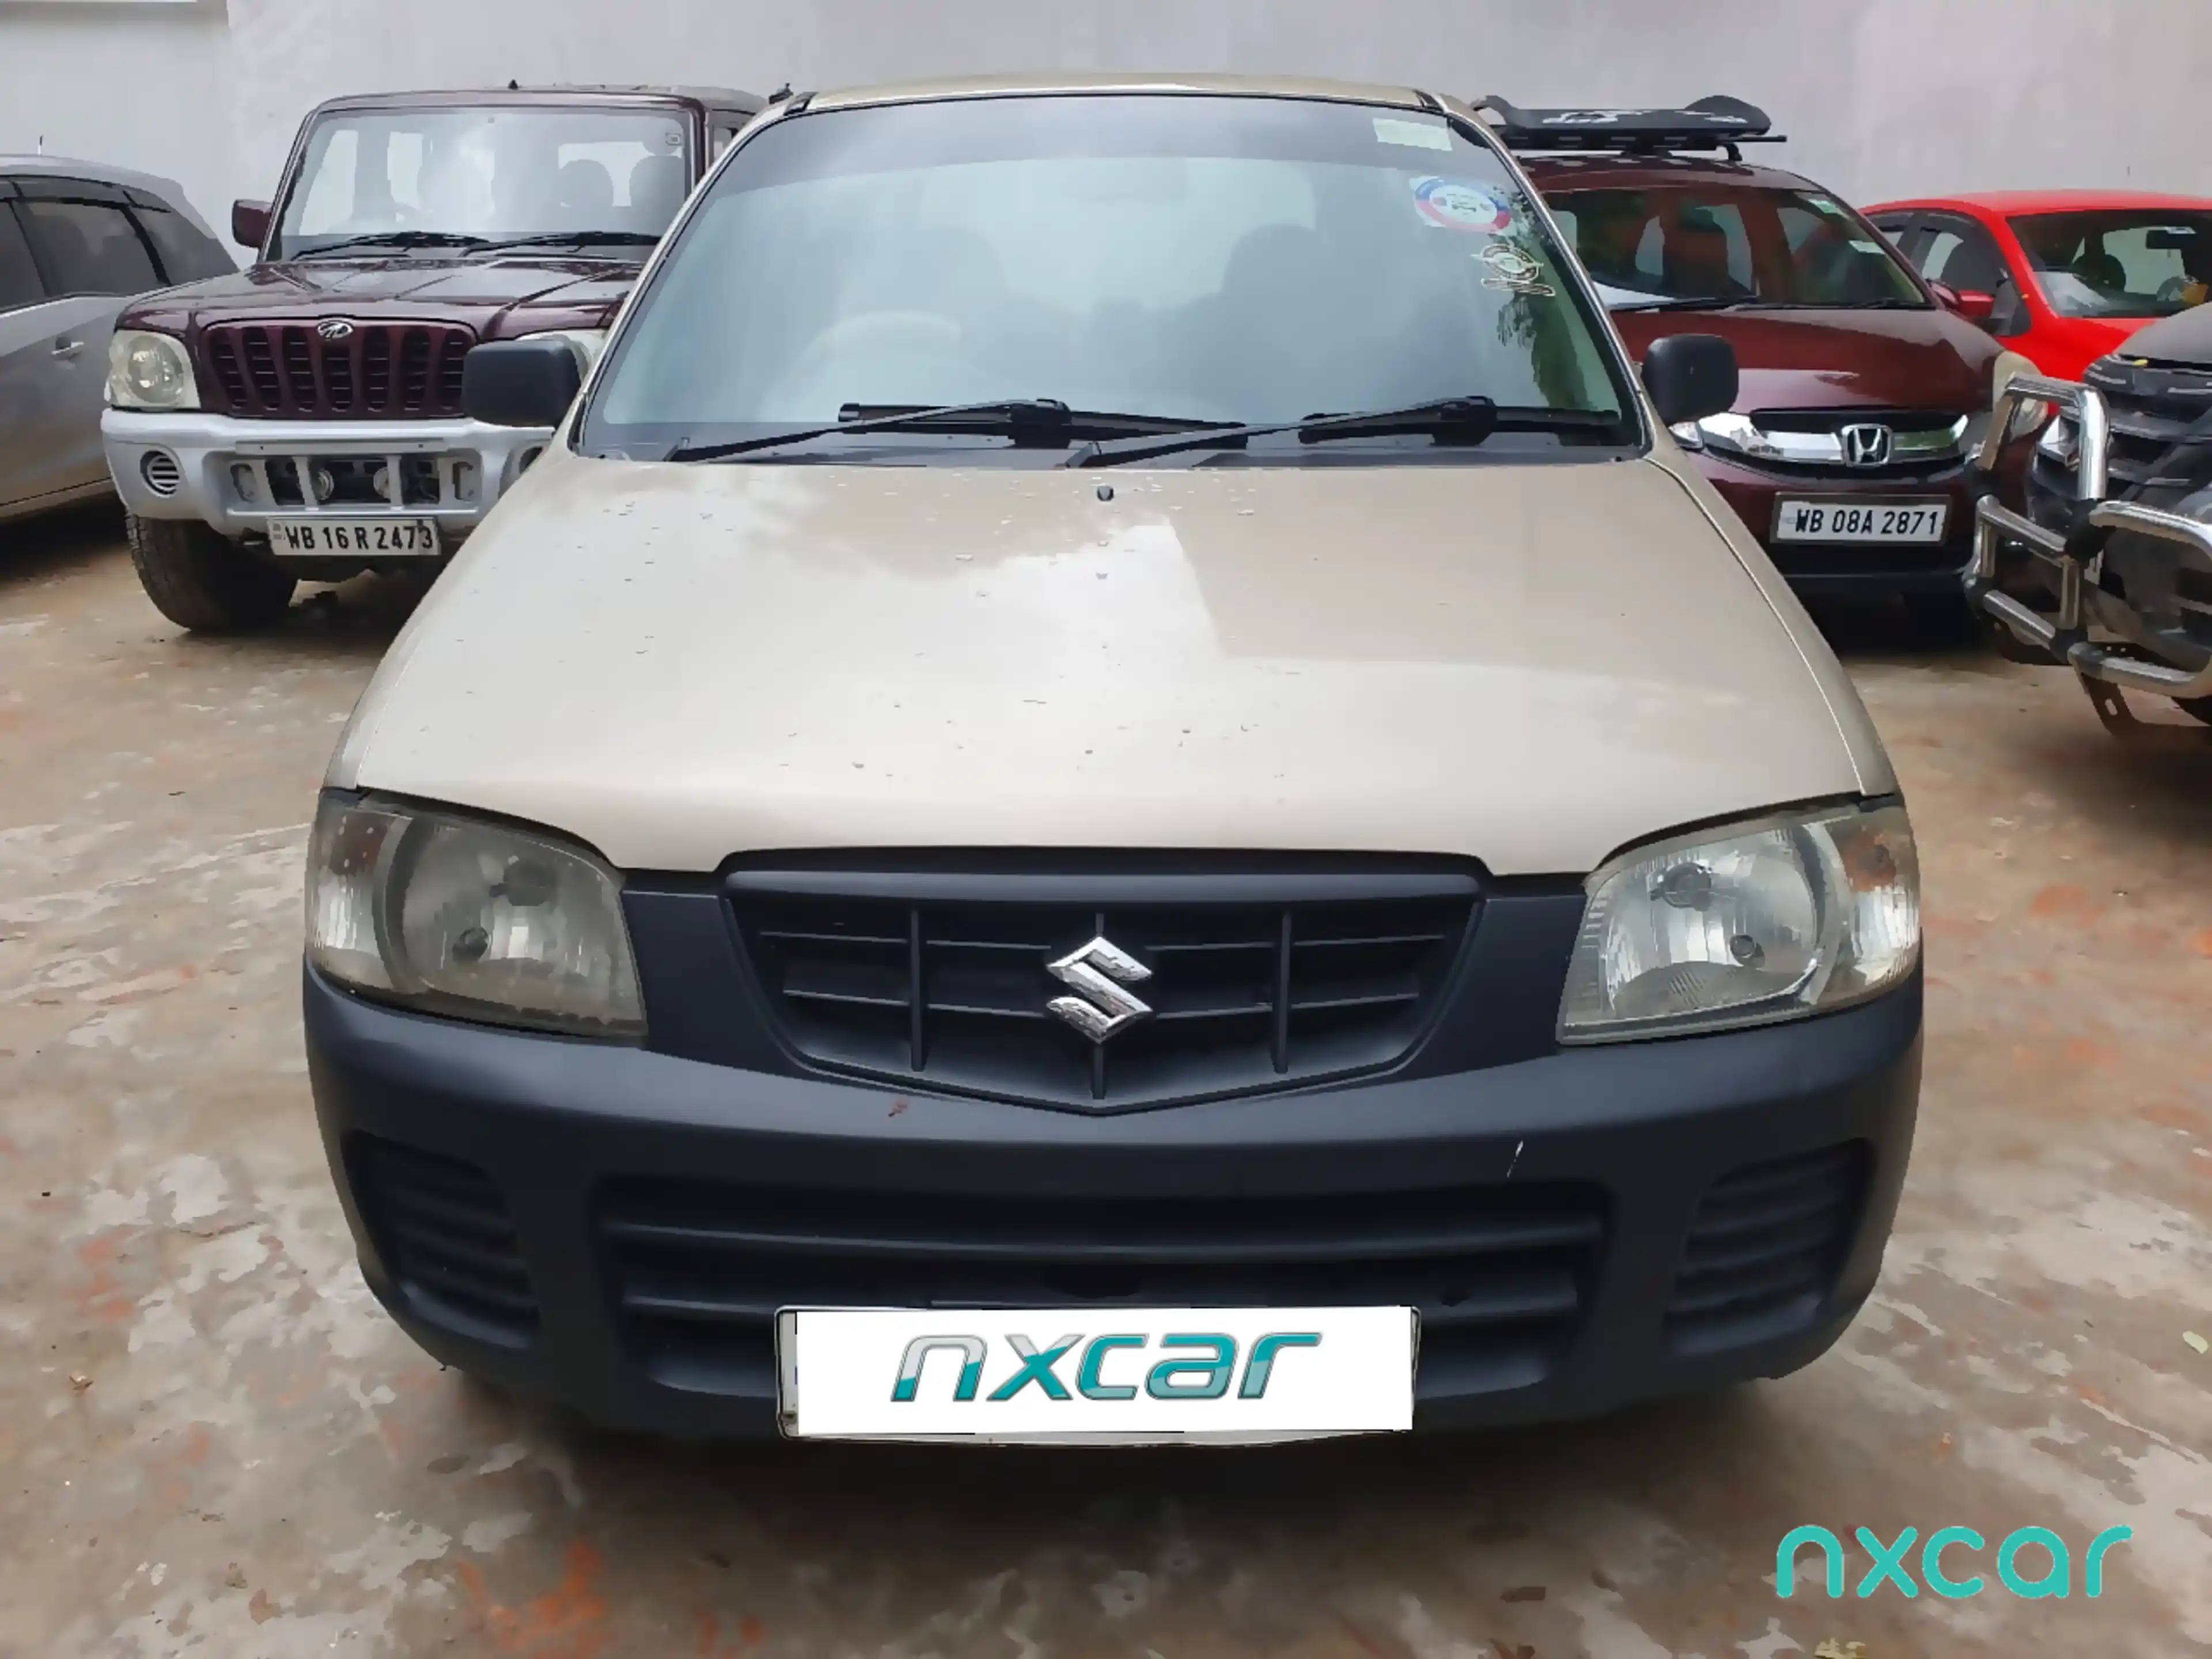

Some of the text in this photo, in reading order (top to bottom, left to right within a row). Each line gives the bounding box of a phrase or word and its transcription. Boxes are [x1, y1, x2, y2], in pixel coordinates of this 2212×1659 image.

[1795, 509, 1938, 535] WB 08A 2871
[285, 526, 434, 550] WB 16 R 2473
